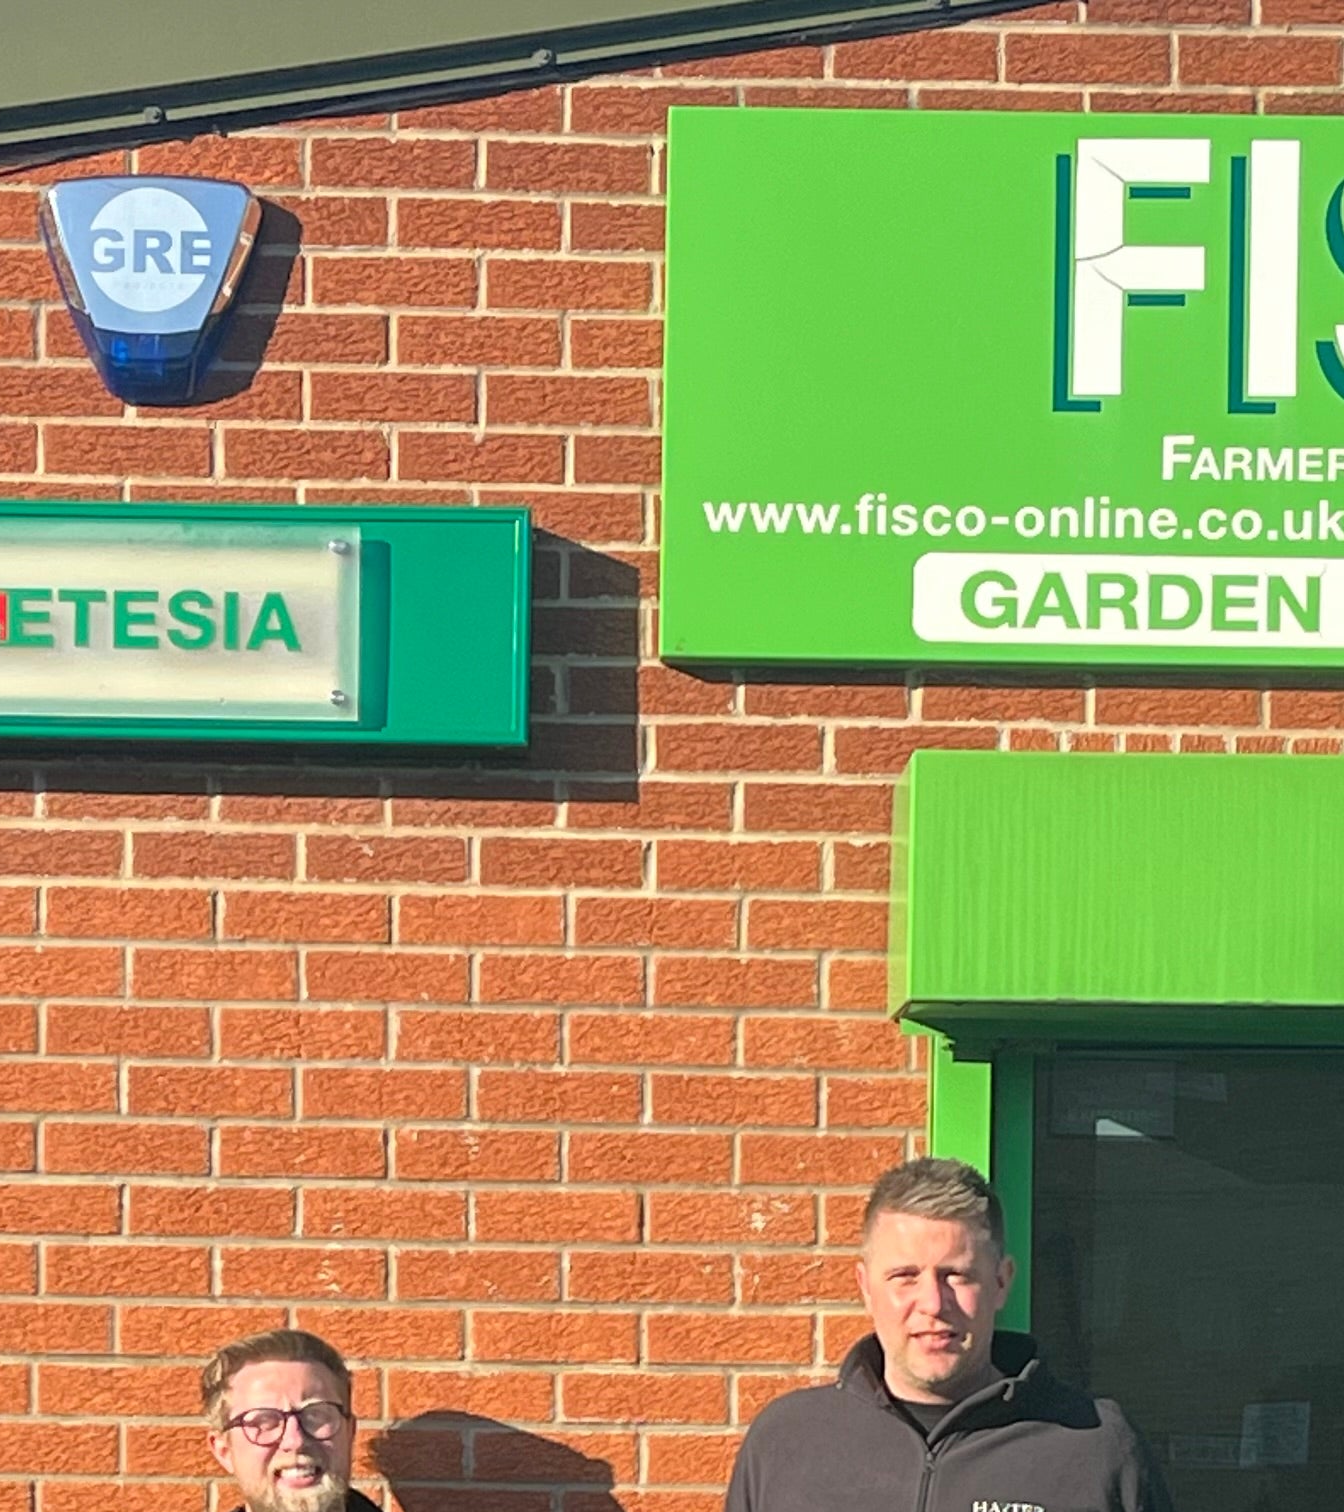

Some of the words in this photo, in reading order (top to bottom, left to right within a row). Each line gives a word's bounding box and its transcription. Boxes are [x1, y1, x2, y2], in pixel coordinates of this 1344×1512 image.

[89, 228, 209, 274] GRE
[1, 589, 301, 652] ETESIA
[959, 569, 1323, 633] GARDEN
